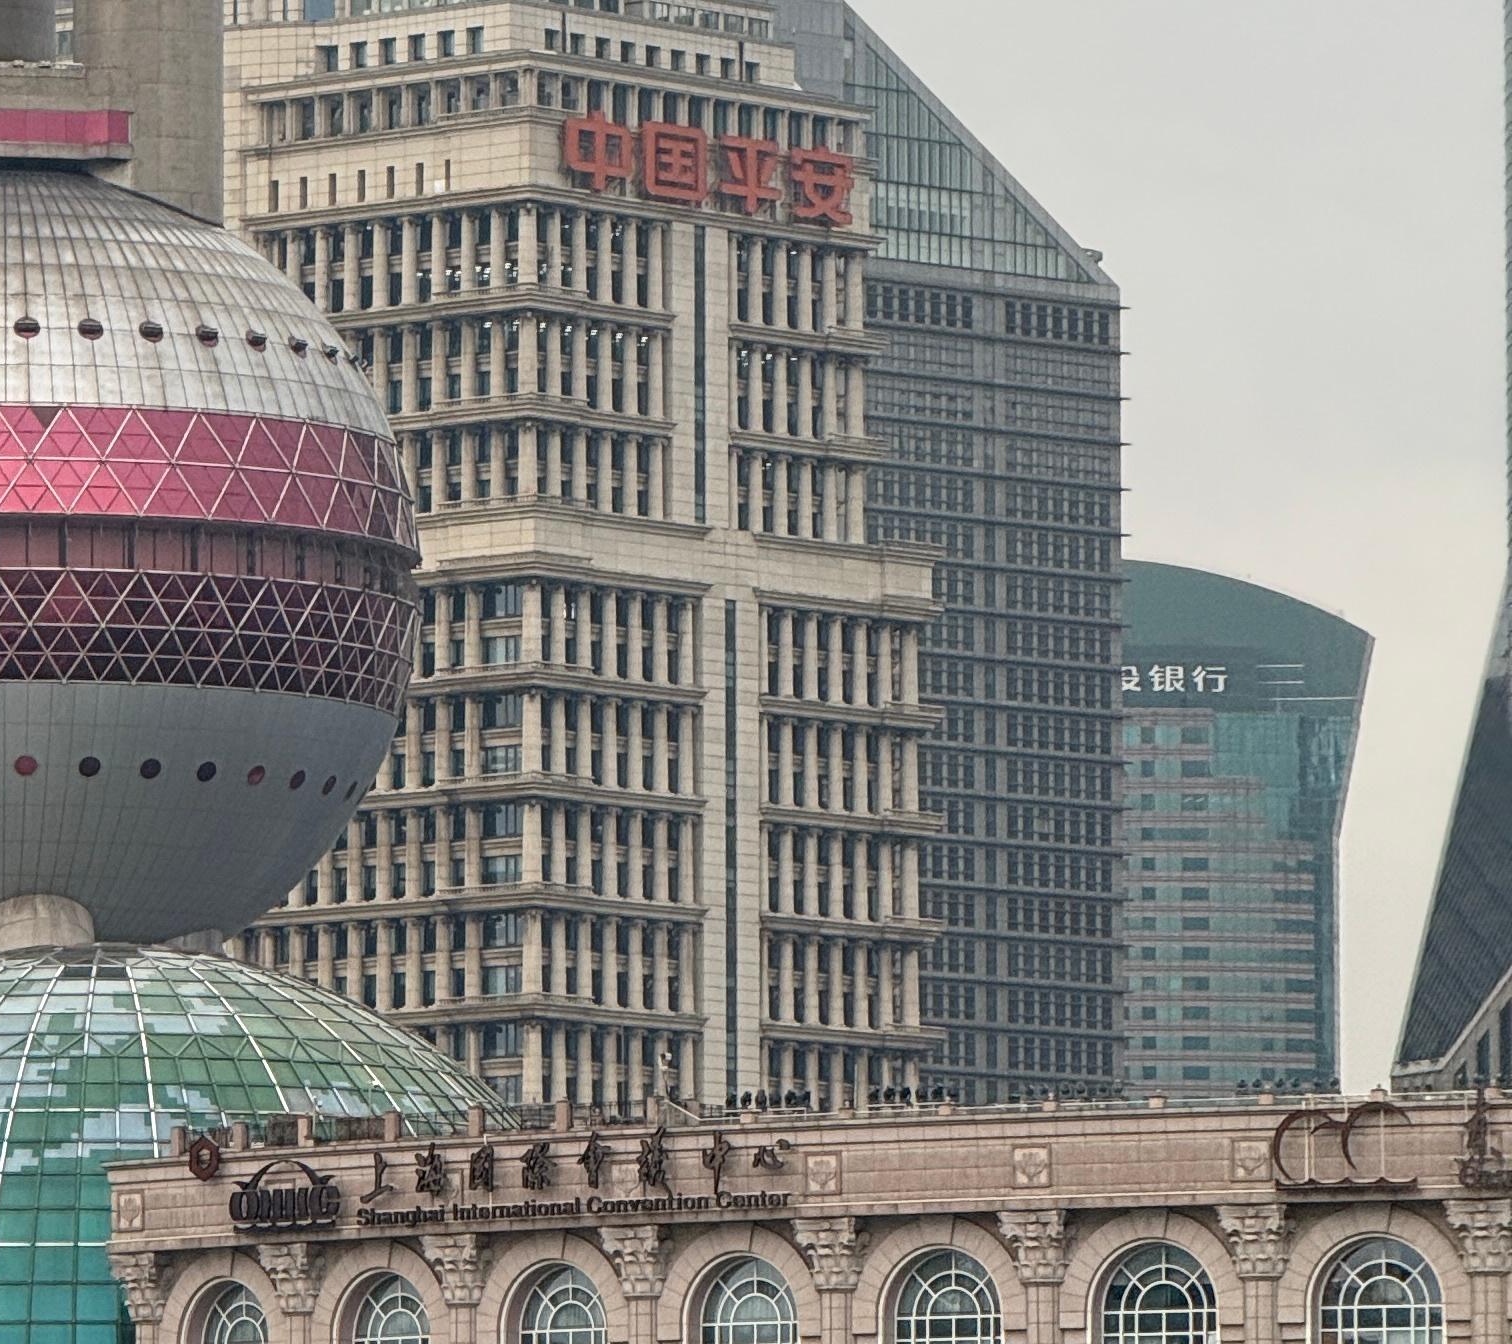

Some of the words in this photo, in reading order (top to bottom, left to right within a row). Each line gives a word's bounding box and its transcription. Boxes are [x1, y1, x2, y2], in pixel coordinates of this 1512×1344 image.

[562, 110, 854, 226] 中国平安
[357, 1205, 445, 1227] Shanghai
[453, 1197, 580, 1222] International
[587, 1192, 708, 1214] Convention
[716, 1190, 792, 1210] Center
